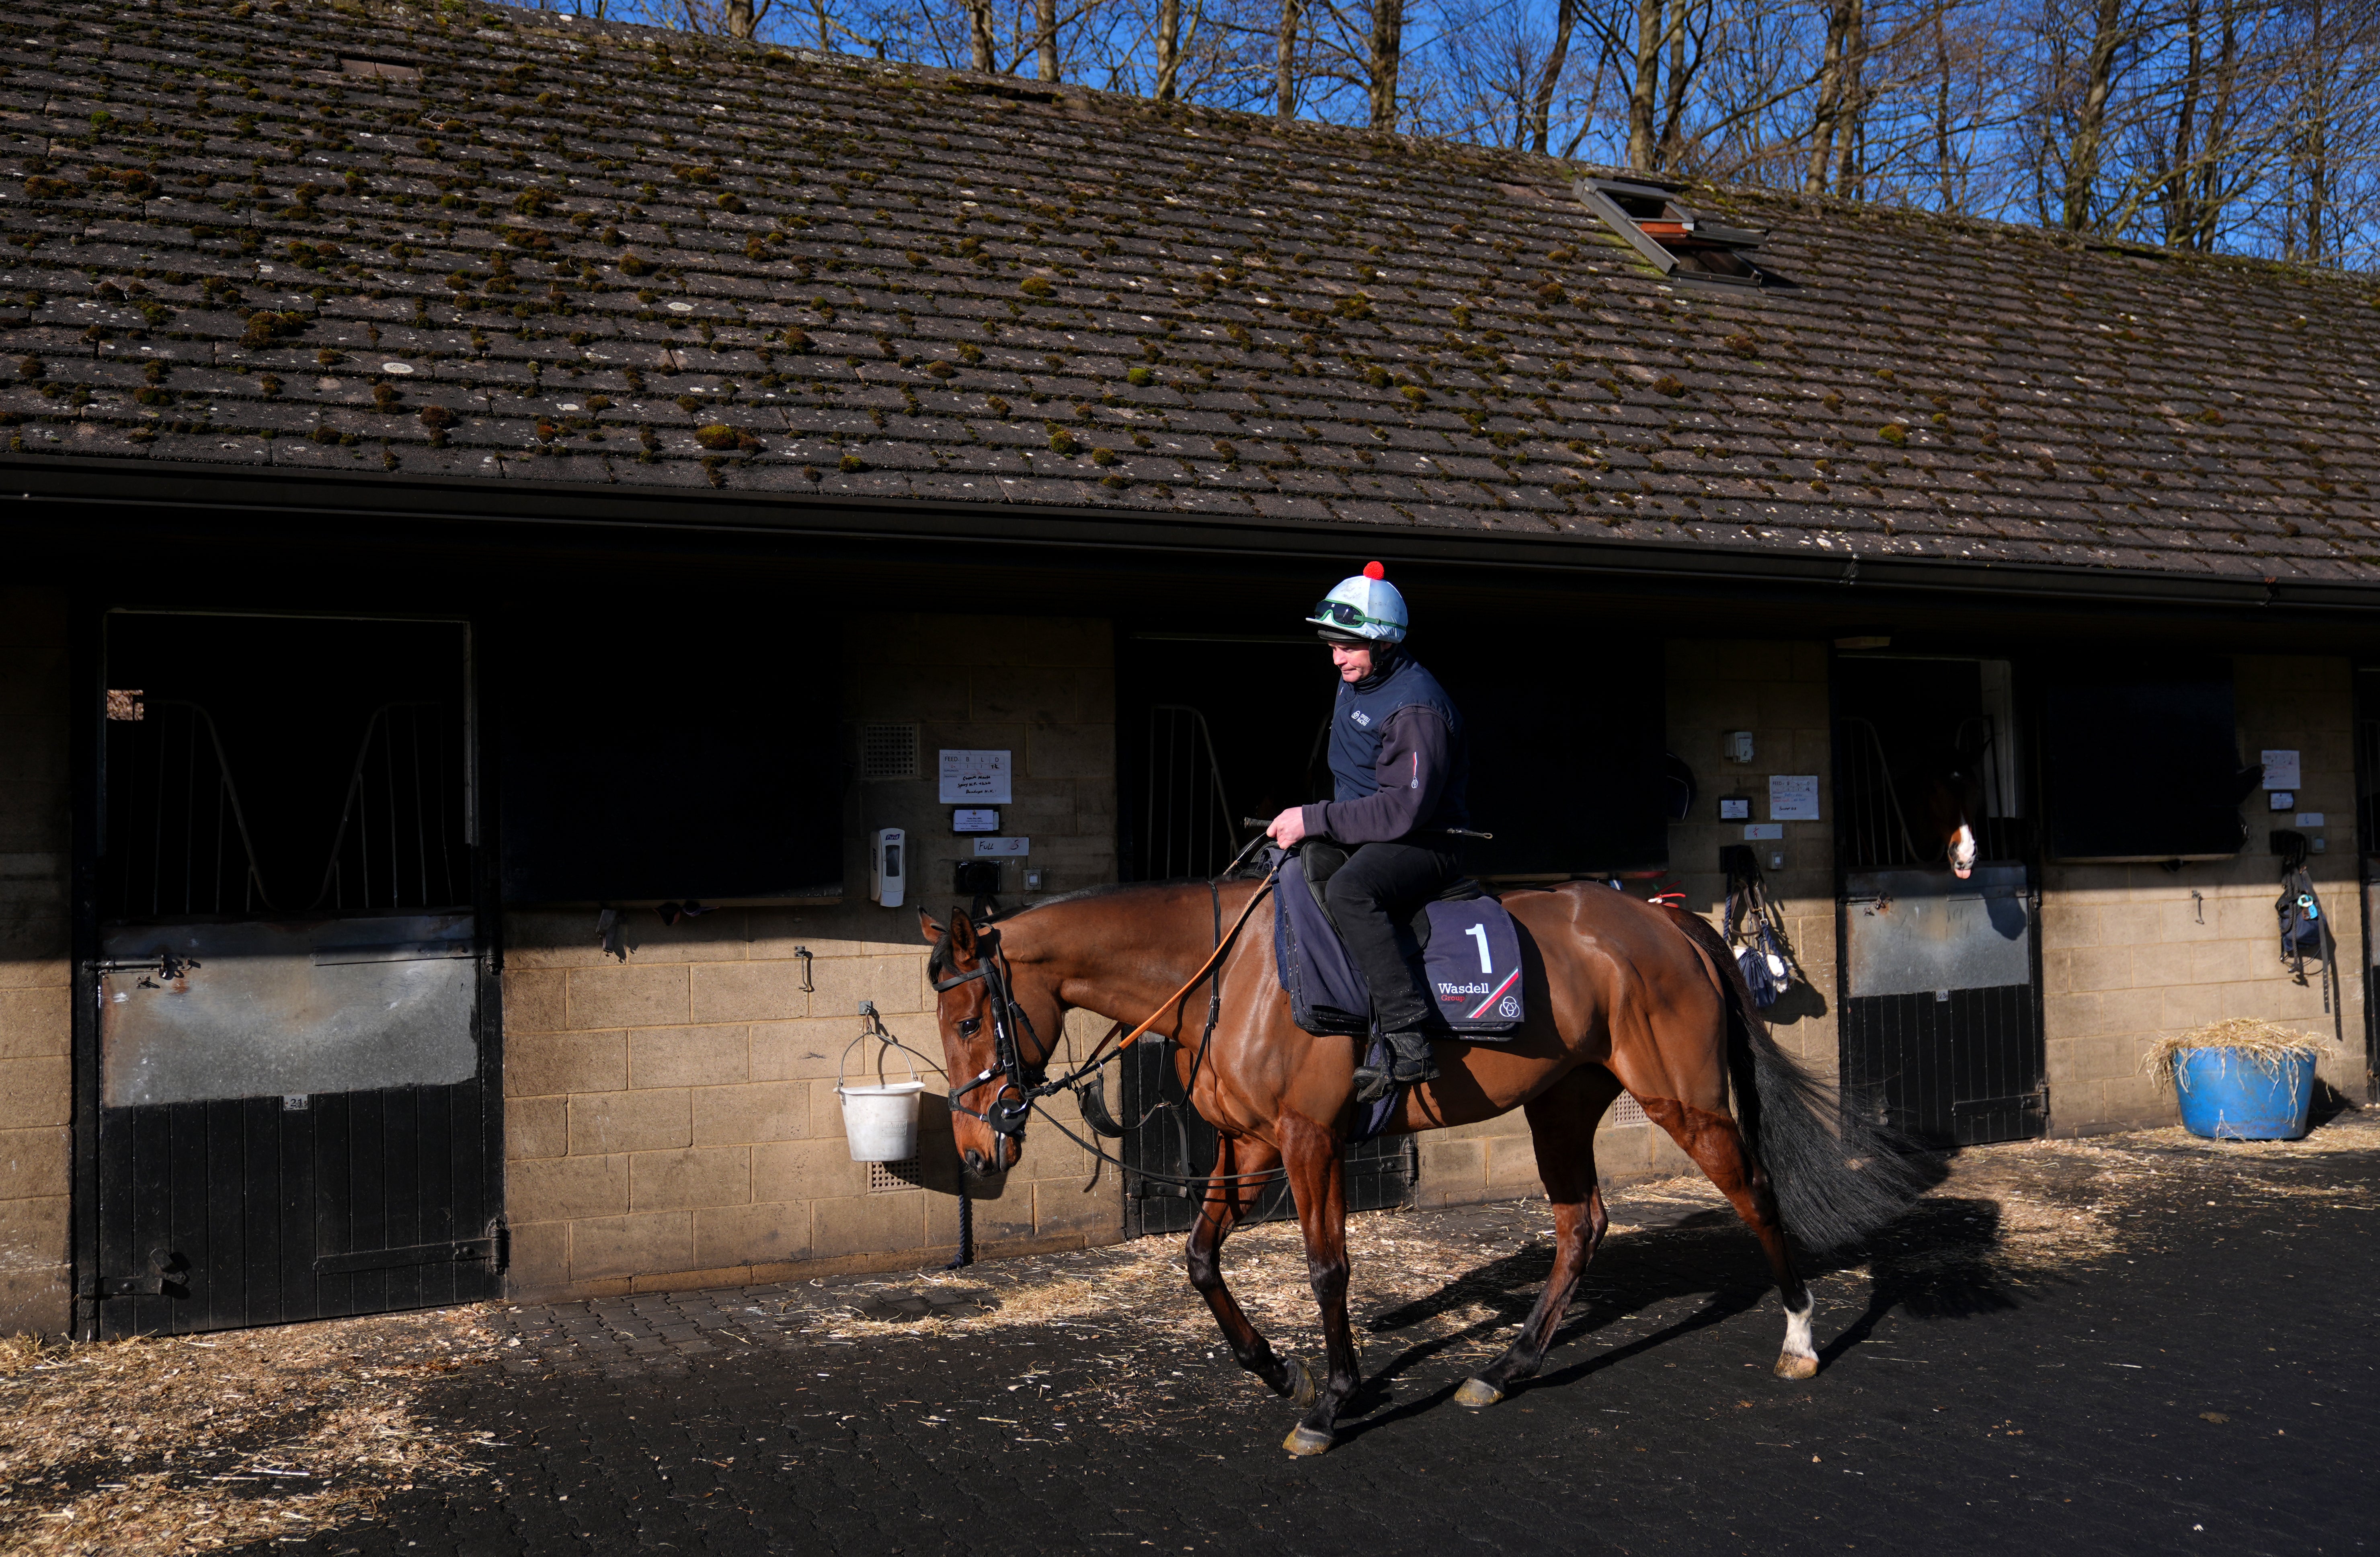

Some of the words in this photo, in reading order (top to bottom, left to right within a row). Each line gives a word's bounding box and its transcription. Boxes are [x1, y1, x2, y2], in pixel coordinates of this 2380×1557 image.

[1465, 923, 1492, 973] 1
[1438, 983, 1489, 994] Wasdell
[290, 1098, 302, 1106] 21
